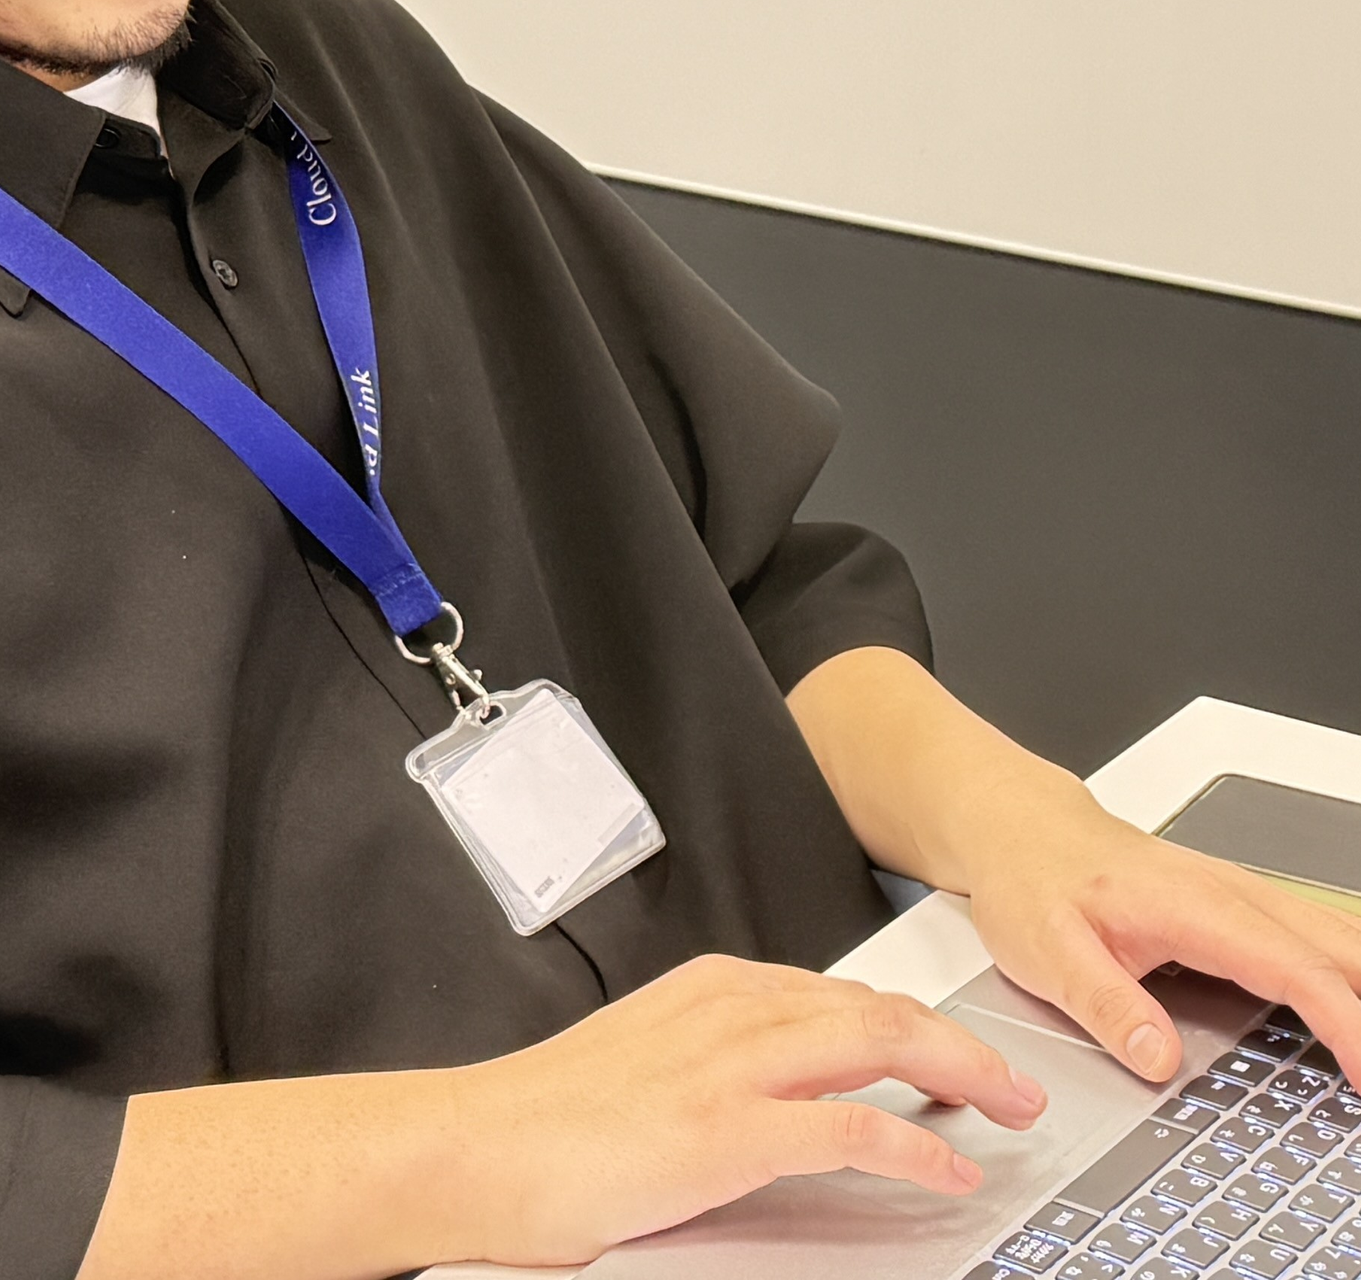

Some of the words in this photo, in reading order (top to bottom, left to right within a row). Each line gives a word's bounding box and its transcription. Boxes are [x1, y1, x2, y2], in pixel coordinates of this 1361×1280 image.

[296, 148, 337, 226] Cloud
[350, 367, 379, 437] Link
[1302, 1076, 1320, 1087] Z
[1274, 1100, 1294, 1111] X
[1248, 1125, 1267, 1136] C
[1317, 1129, 1337, 1140] D
[1220, 1152, 1238, 1162] V
[1293, 1155, 1309, 1166] F
[1190, 1176, 1209, 1187] B
[1260, 1182, 1279, 1194] G
[1328, 1193, 1348, 1204] T
[1159, 1204, 1180, 1216] N
[1231, 1208, 1252, 1221] H
[1299, 1221, 1319, 1232] Y
[1127, 1230, 1149, 1246] M
[1203, 1237, 1219, 1248] J
[1270, 1249, 1290, 1261] U
[1170, 1266, 1191, 1278] K
